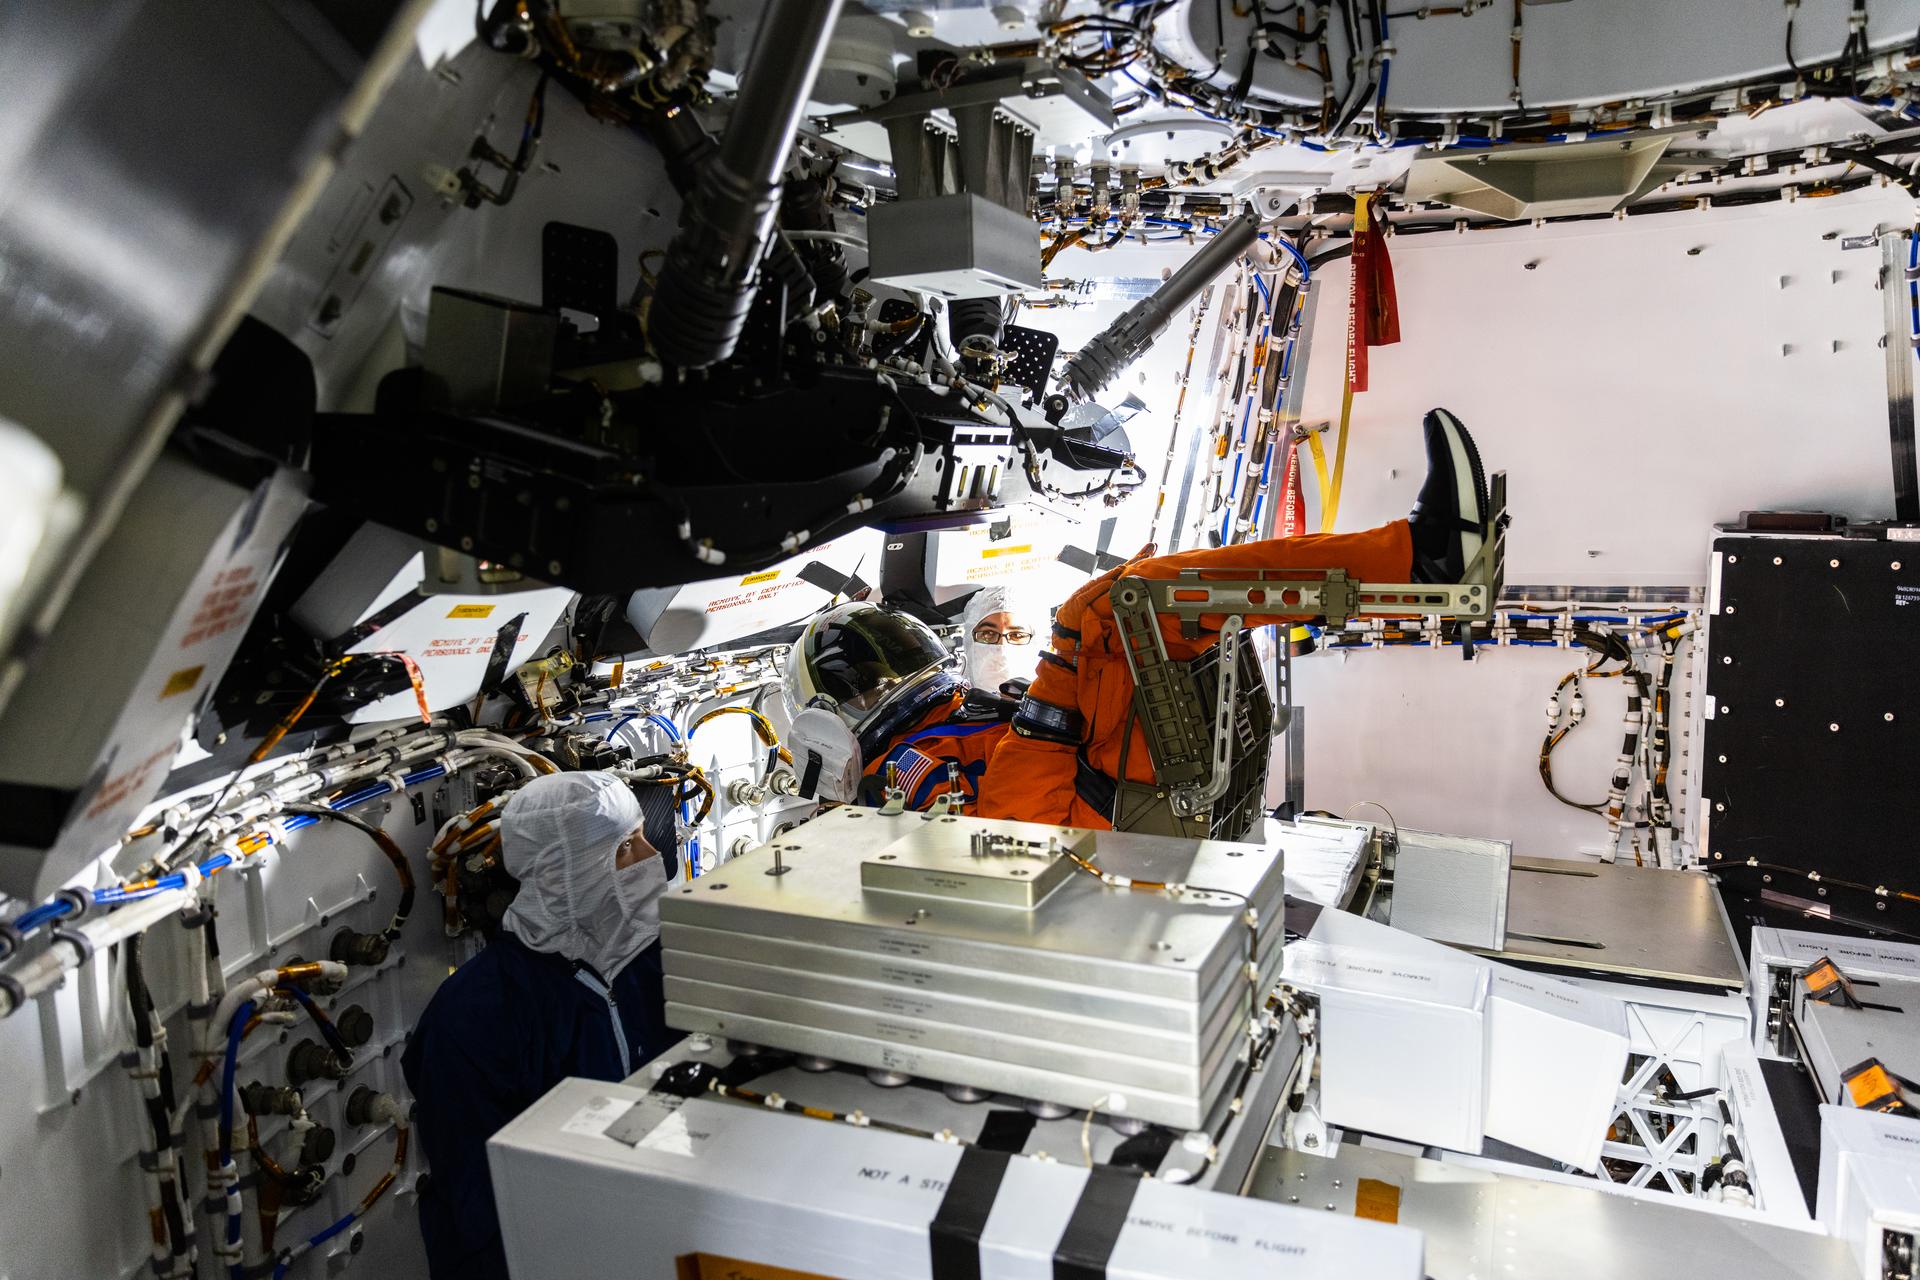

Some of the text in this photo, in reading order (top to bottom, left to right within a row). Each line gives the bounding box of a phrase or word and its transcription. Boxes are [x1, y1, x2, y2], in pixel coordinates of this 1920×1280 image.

[1348, 352, 1356, 383] FLIGHT
[1288, 454, 1298, 488] REMOVE
[1285, 489, 1296, 521] BEFORE
[705, 591, 779, 615] PERSONNEL ONLY
[708, 580, 806, 608] REMOVE BY CERTIFIED
[476, 646, 491, 654] ONL
[1797, 943, 1916, 963] REMOVE BEFORE FLIGHT
[1347, 964, 1383, 974] BEFORE
[1391, 971, 1431, 981] REMOVE
[858, 1167, 947, 1191] NOT A STE
[1129, 1216, 1307, 1256] EMOVE BEFORE FLIGHT
